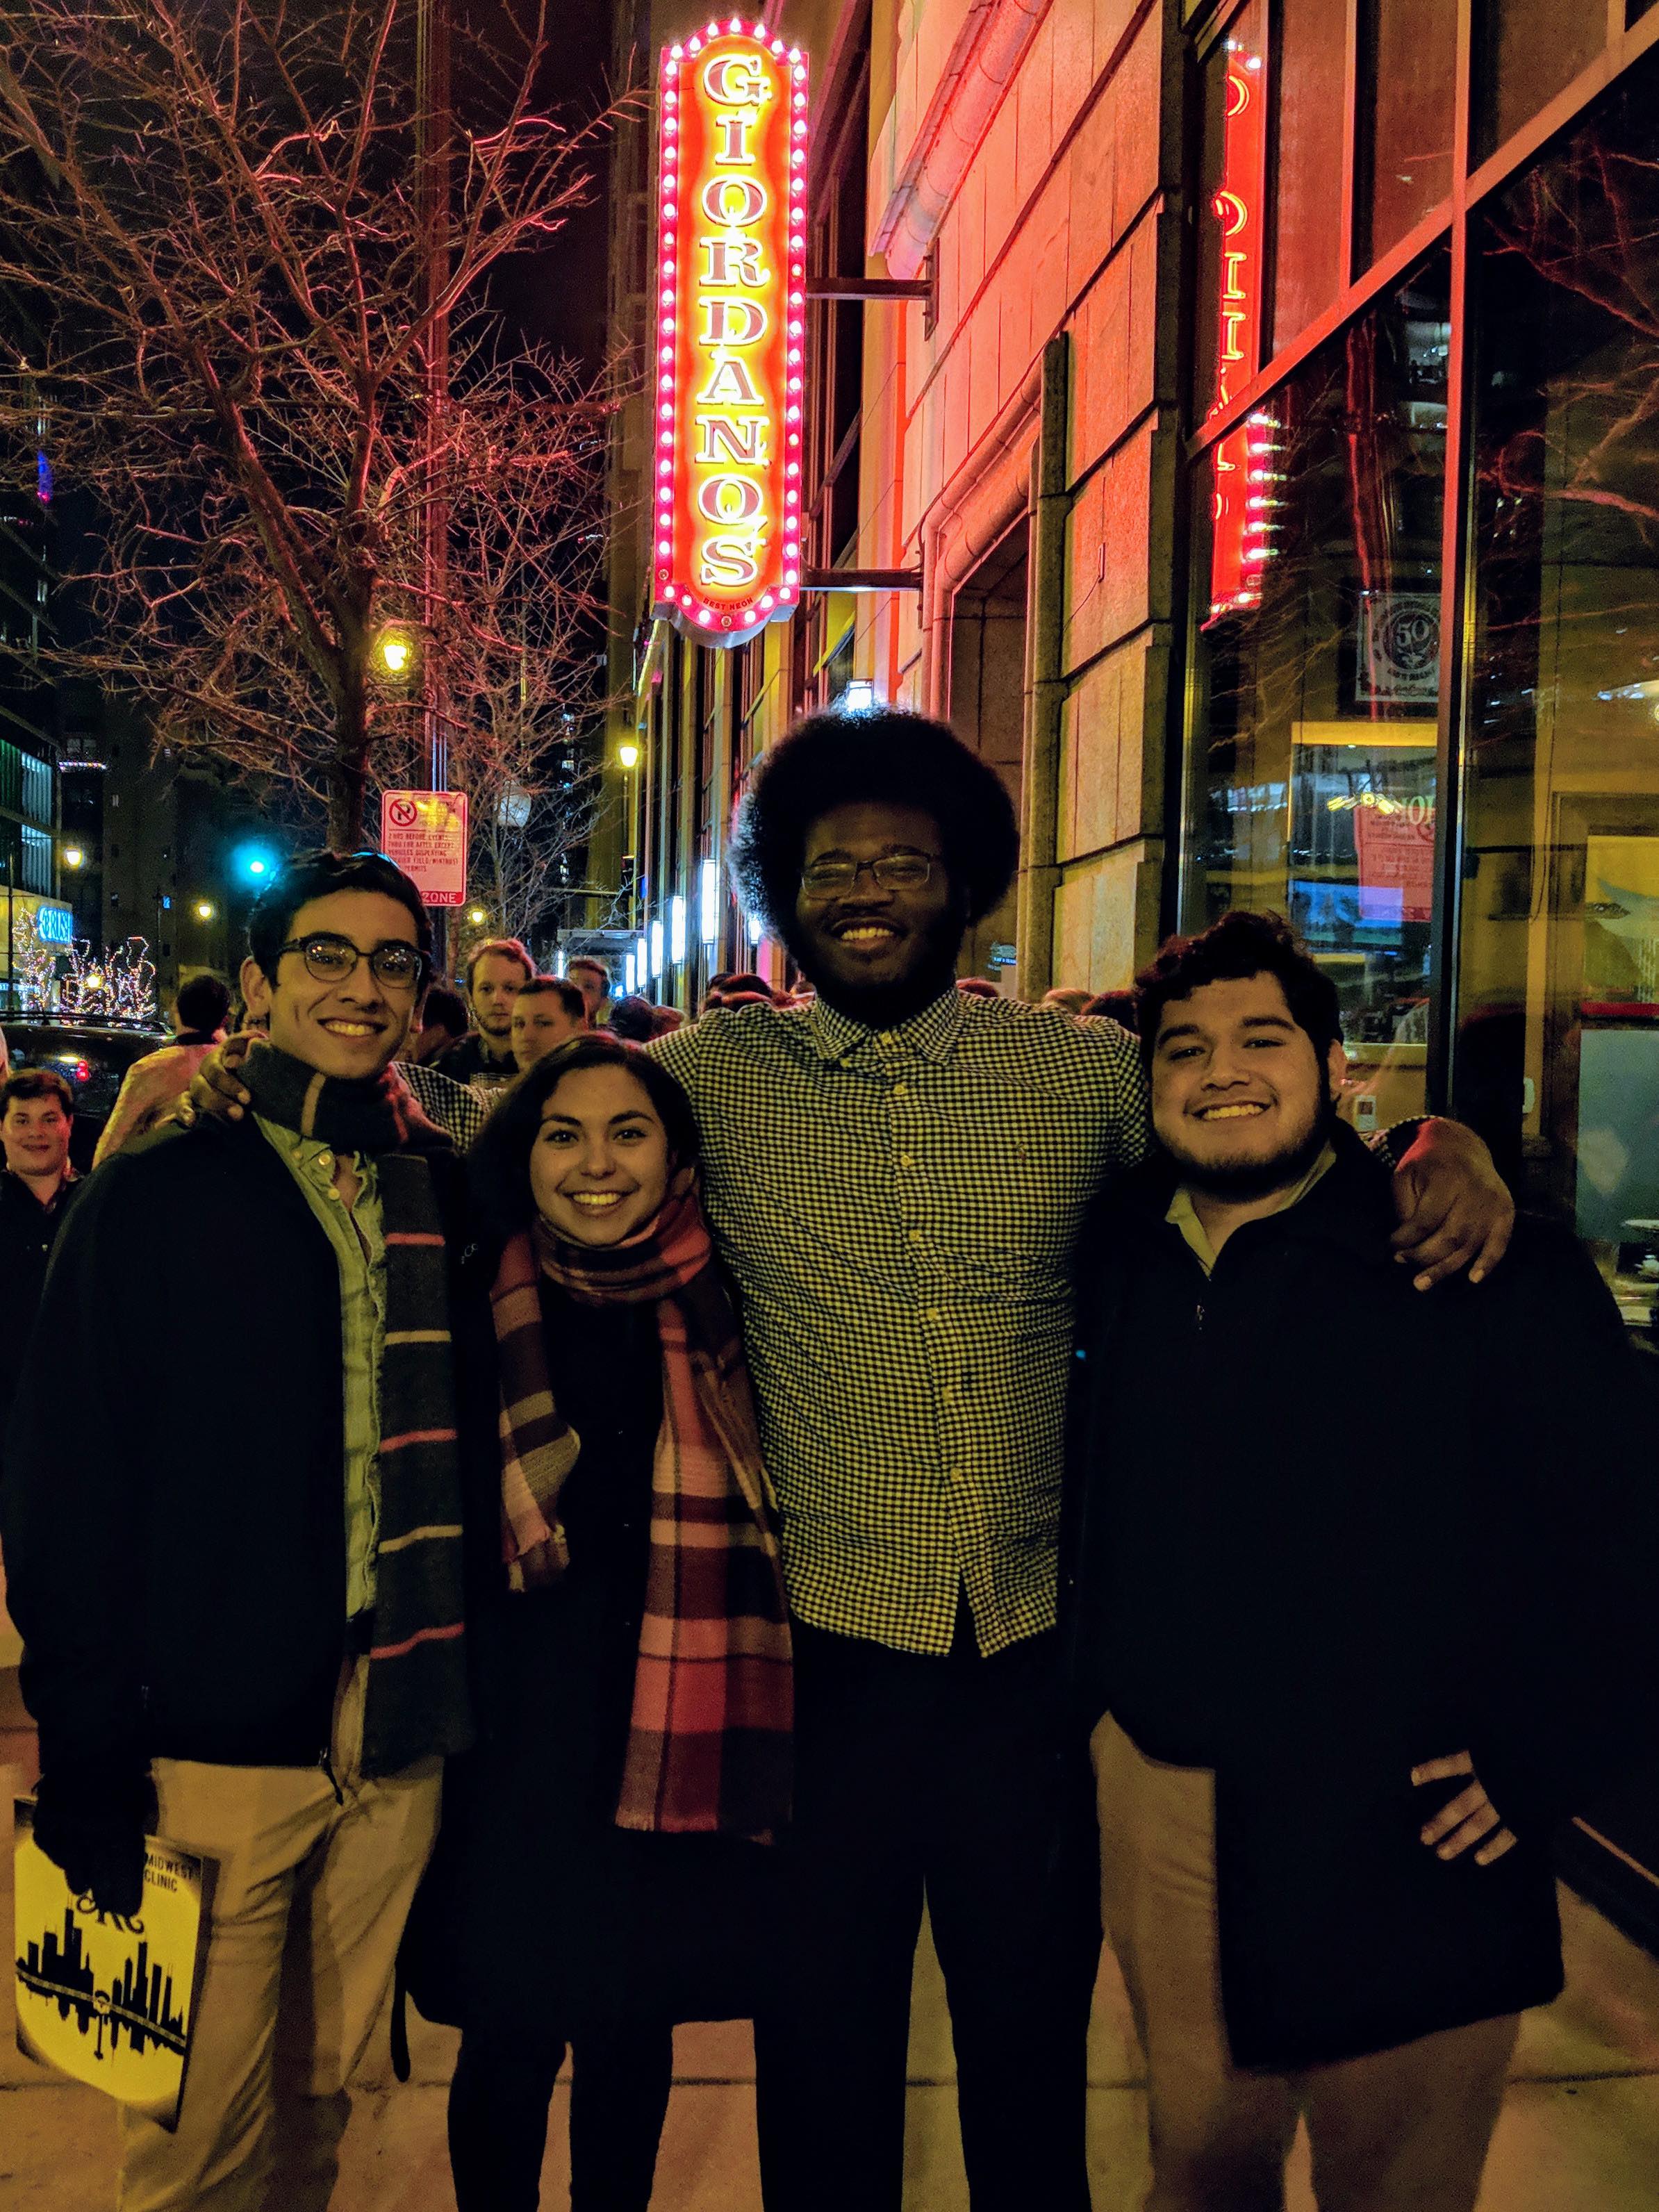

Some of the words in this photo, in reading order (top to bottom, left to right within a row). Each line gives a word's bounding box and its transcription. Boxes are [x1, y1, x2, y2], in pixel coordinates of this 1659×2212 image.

[703, 597, 726, 610] BEST
[729, 597, 753, 611] NEON
[1396, 619, 1431, 647] 50
[415, 849, 447, 857] DISPLAYING
[421, 891, 456, 904] ZONE
[144, 1869, 178, 1893] CLINIC
